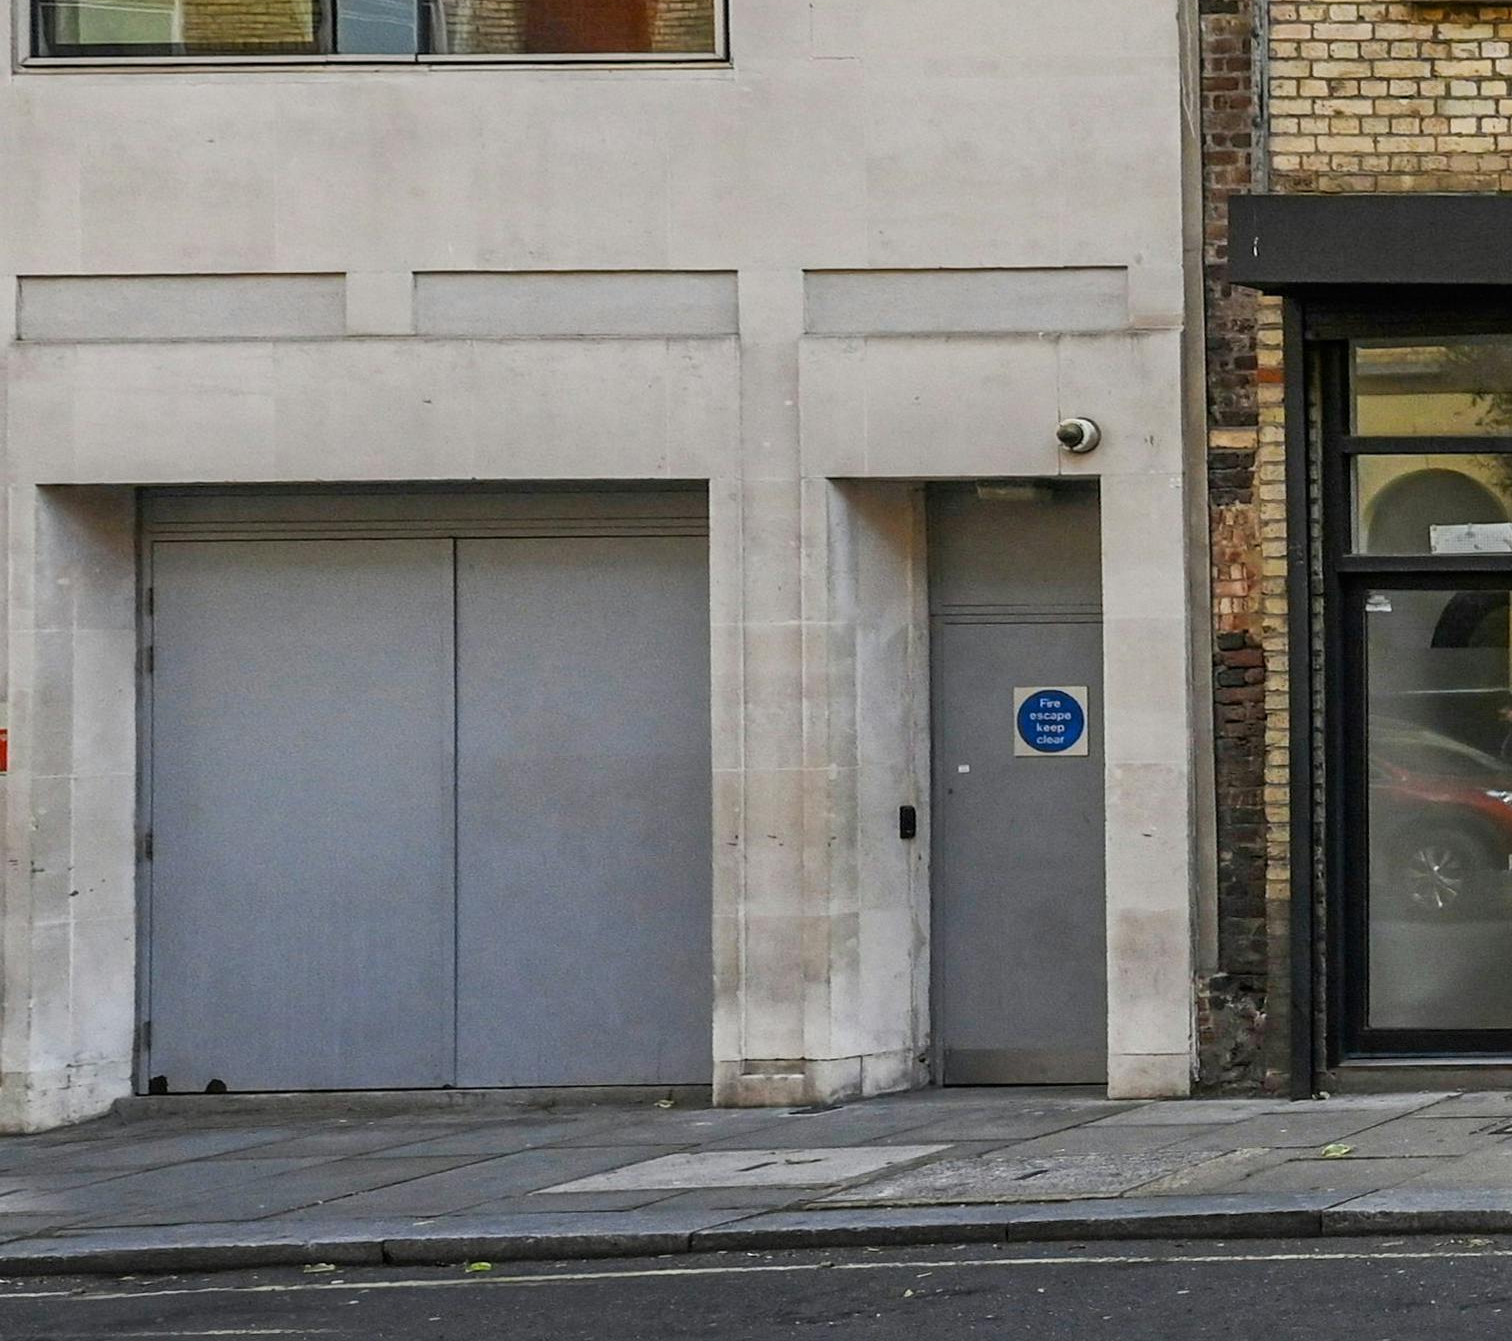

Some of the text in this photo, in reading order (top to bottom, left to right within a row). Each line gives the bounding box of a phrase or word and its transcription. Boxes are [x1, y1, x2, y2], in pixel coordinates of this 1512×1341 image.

[1040, 698, 1061, 708] Fire
[1029, 712, 1072, 722] escape
[1036, 723, 1065, 733] keep
[1036, 735, 1065, 744] clear
